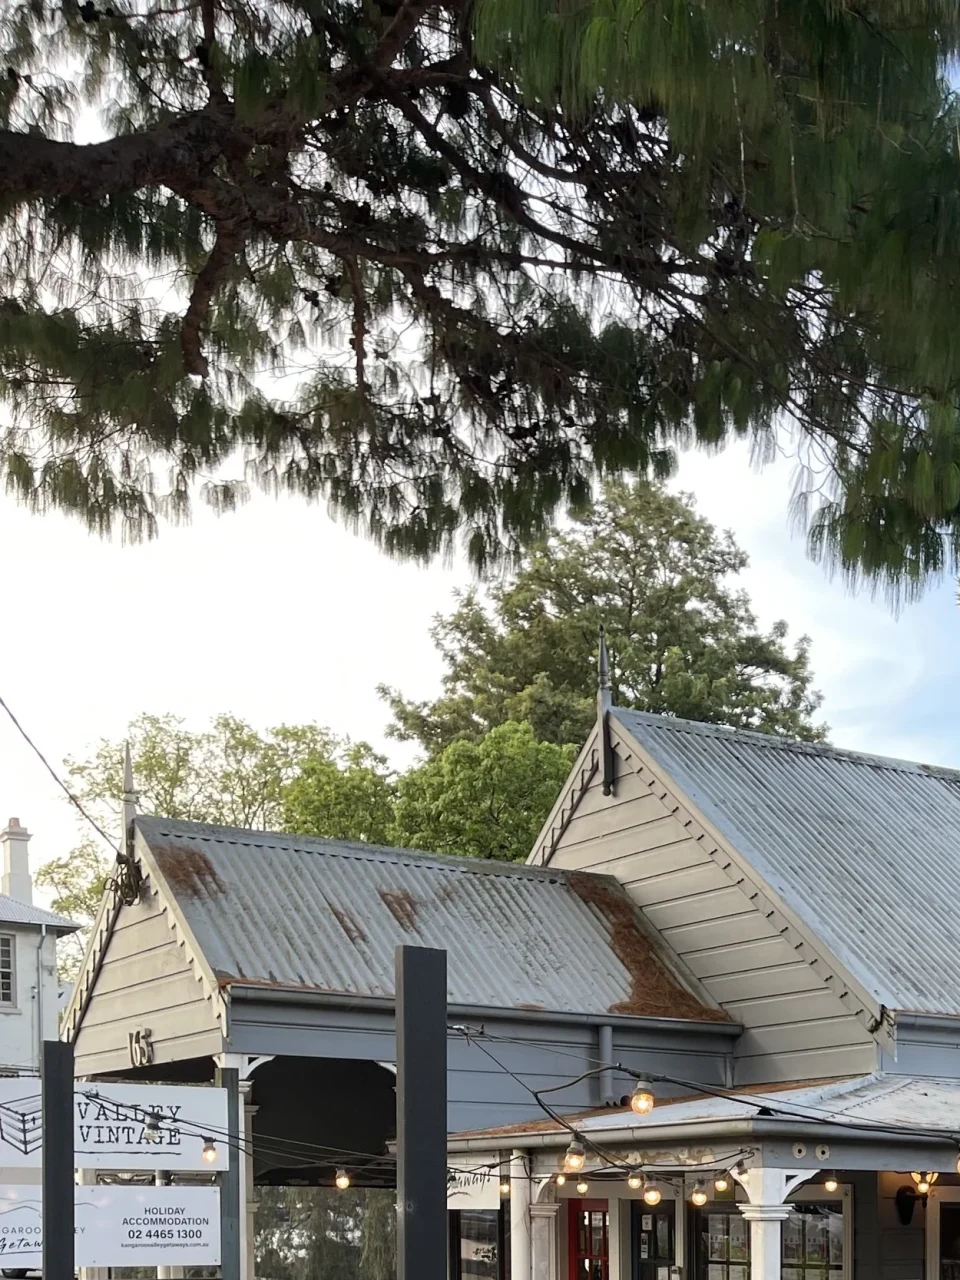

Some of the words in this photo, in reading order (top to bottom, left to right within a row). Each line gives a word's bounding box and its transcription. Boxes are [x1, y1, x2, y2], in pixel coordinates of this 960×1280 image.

[76, 1101, 182, 1123] VALLEY
[77, 1125, 182, 1145] VINTAGE
[144, 1207, 186, 1216] HOLIDAY
[122, 1217, 209, 1226] ACCOMMODATION
[128, 1229, 142, 1240] 02
[145, 1229, 174, 1240] 4465
[177, 1229, 202, 1240] 1300
